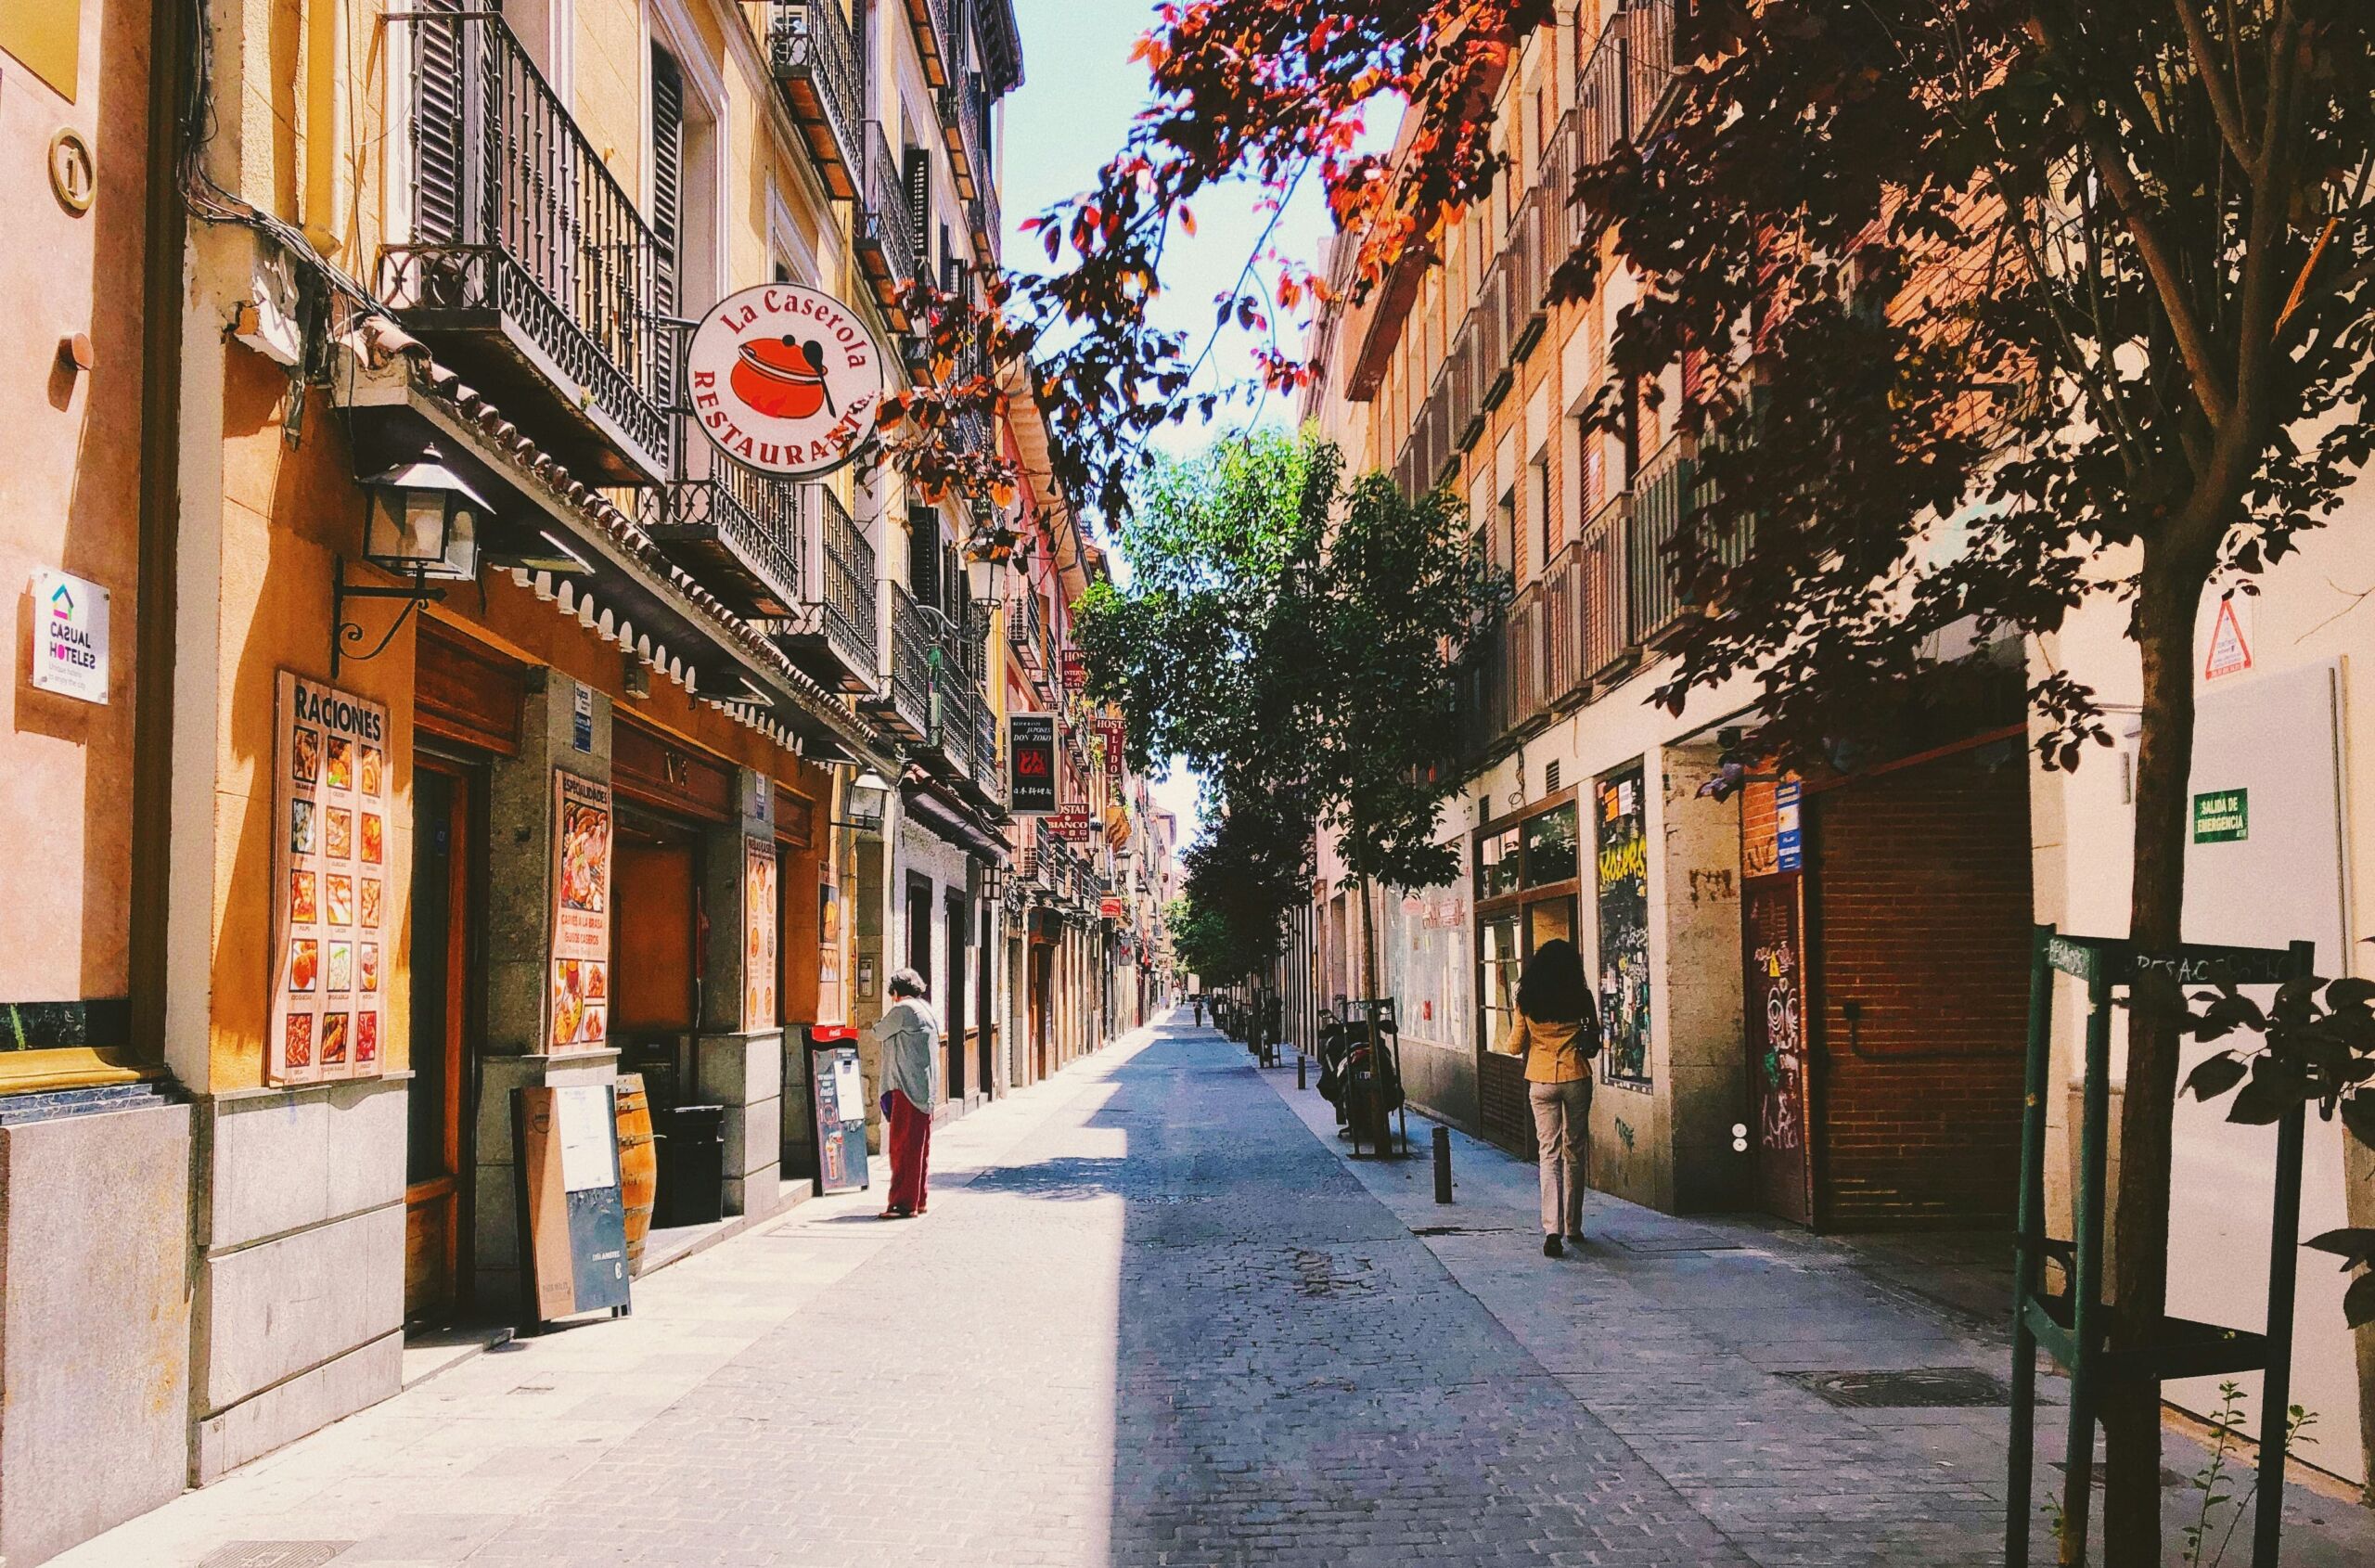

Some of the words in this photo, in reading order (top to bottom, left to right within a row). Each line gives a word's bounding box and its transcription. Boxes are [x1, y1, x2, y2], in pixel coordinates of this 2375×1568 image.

[720, 304, 759, 335] La
[764, 289, 867, 369] Caserola
[694, 370, 875, 465] RESTAURANT
[50, 621, 91, 649] CASUAL
[49, 641, 96, 670] HOTELES
[295, 685, 381, 742] RACIONES
[1013, 734, 1030, 742] DON
[1033, 734, 1052, 742] ZOKO
[2201, 798, 2227, 816] SALIDA
[2227, 797, 2239, 812] DE
[2198, 815, 2243, 833] EMERGENCIA
